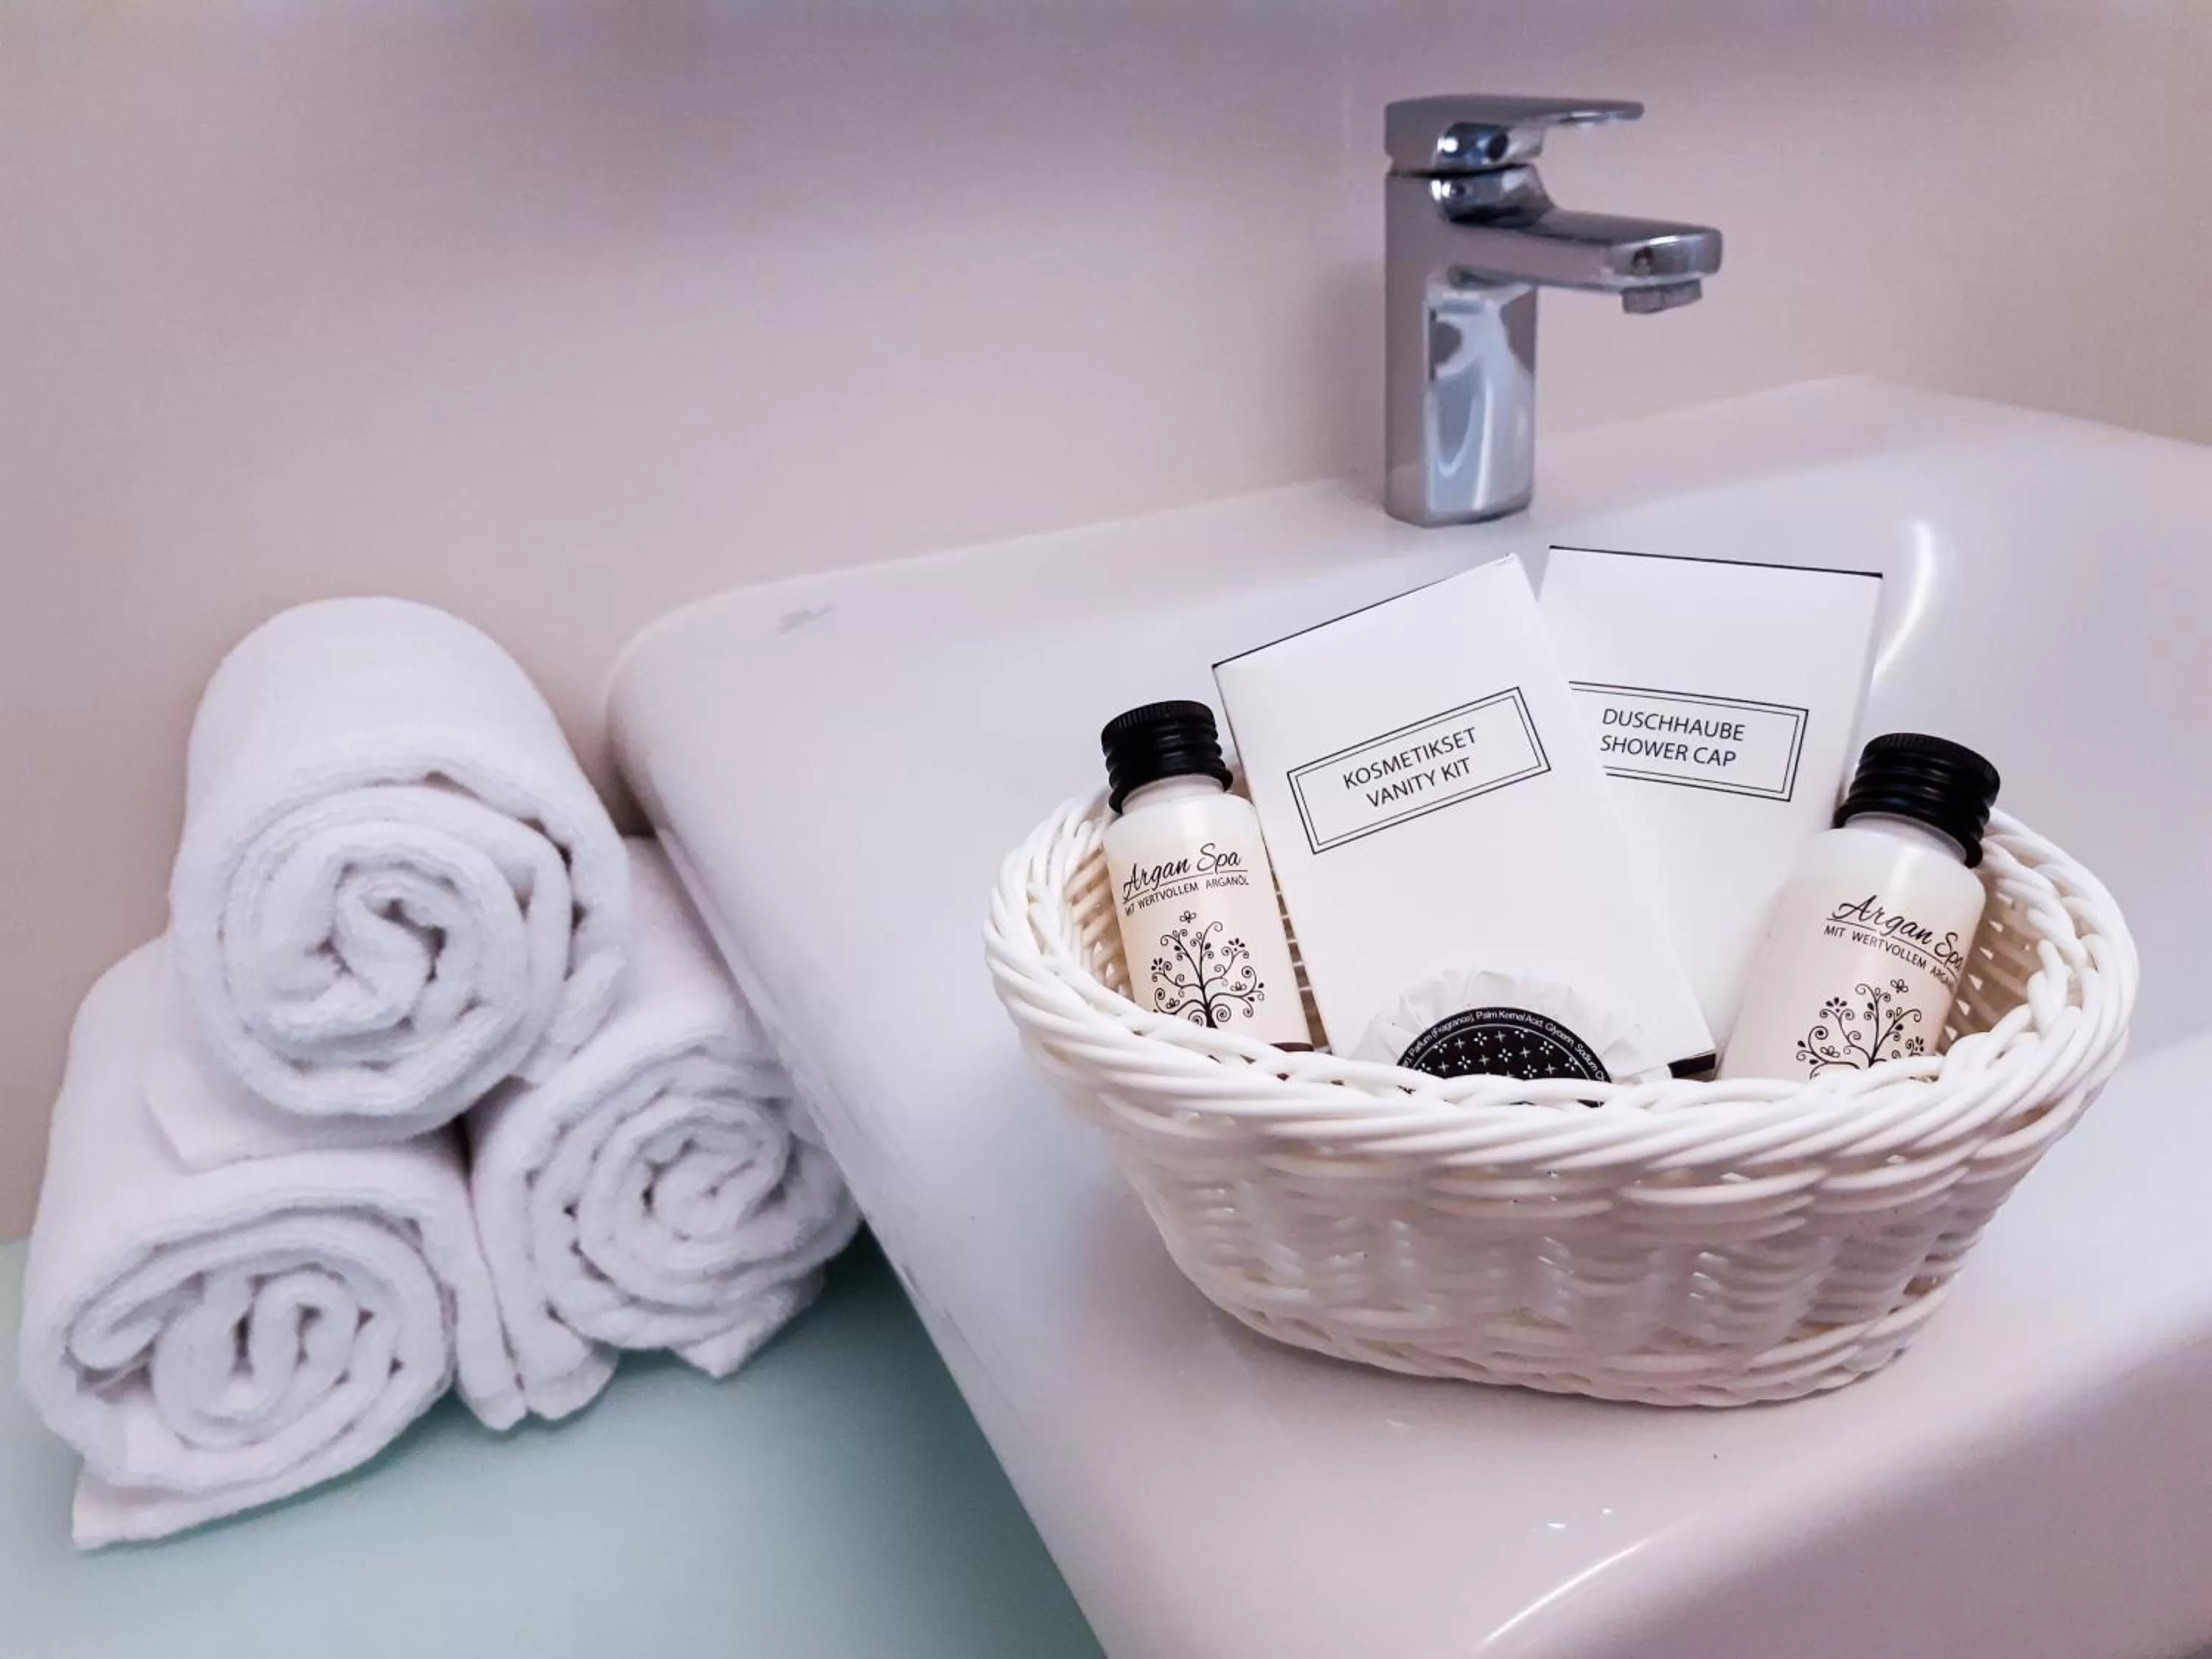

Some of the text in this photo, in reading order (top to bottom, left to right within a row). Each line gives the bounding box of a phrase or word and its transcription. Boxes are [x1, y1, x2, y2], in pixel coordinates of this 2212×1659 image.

[1601, 708, 1746, 742] DUSCHHAUBE
[1343, 726, 1475, 790] KOSMETIKSET
[1600, 734, 1736, 767] SHOWER CAP
[1366, 757, 1472, 807] VANITY KIT
[1123, 842, 1242, 900] Argan Spa
[1124, 874, 1250, 917] MIT WERTVOLLEM ARGANÖL
[1823, 925, 1846, 937] MIT
[1851, 930, 1927, 970] WERTVOLLEM
[1832, 894, 1964, 971] Argan Spa
